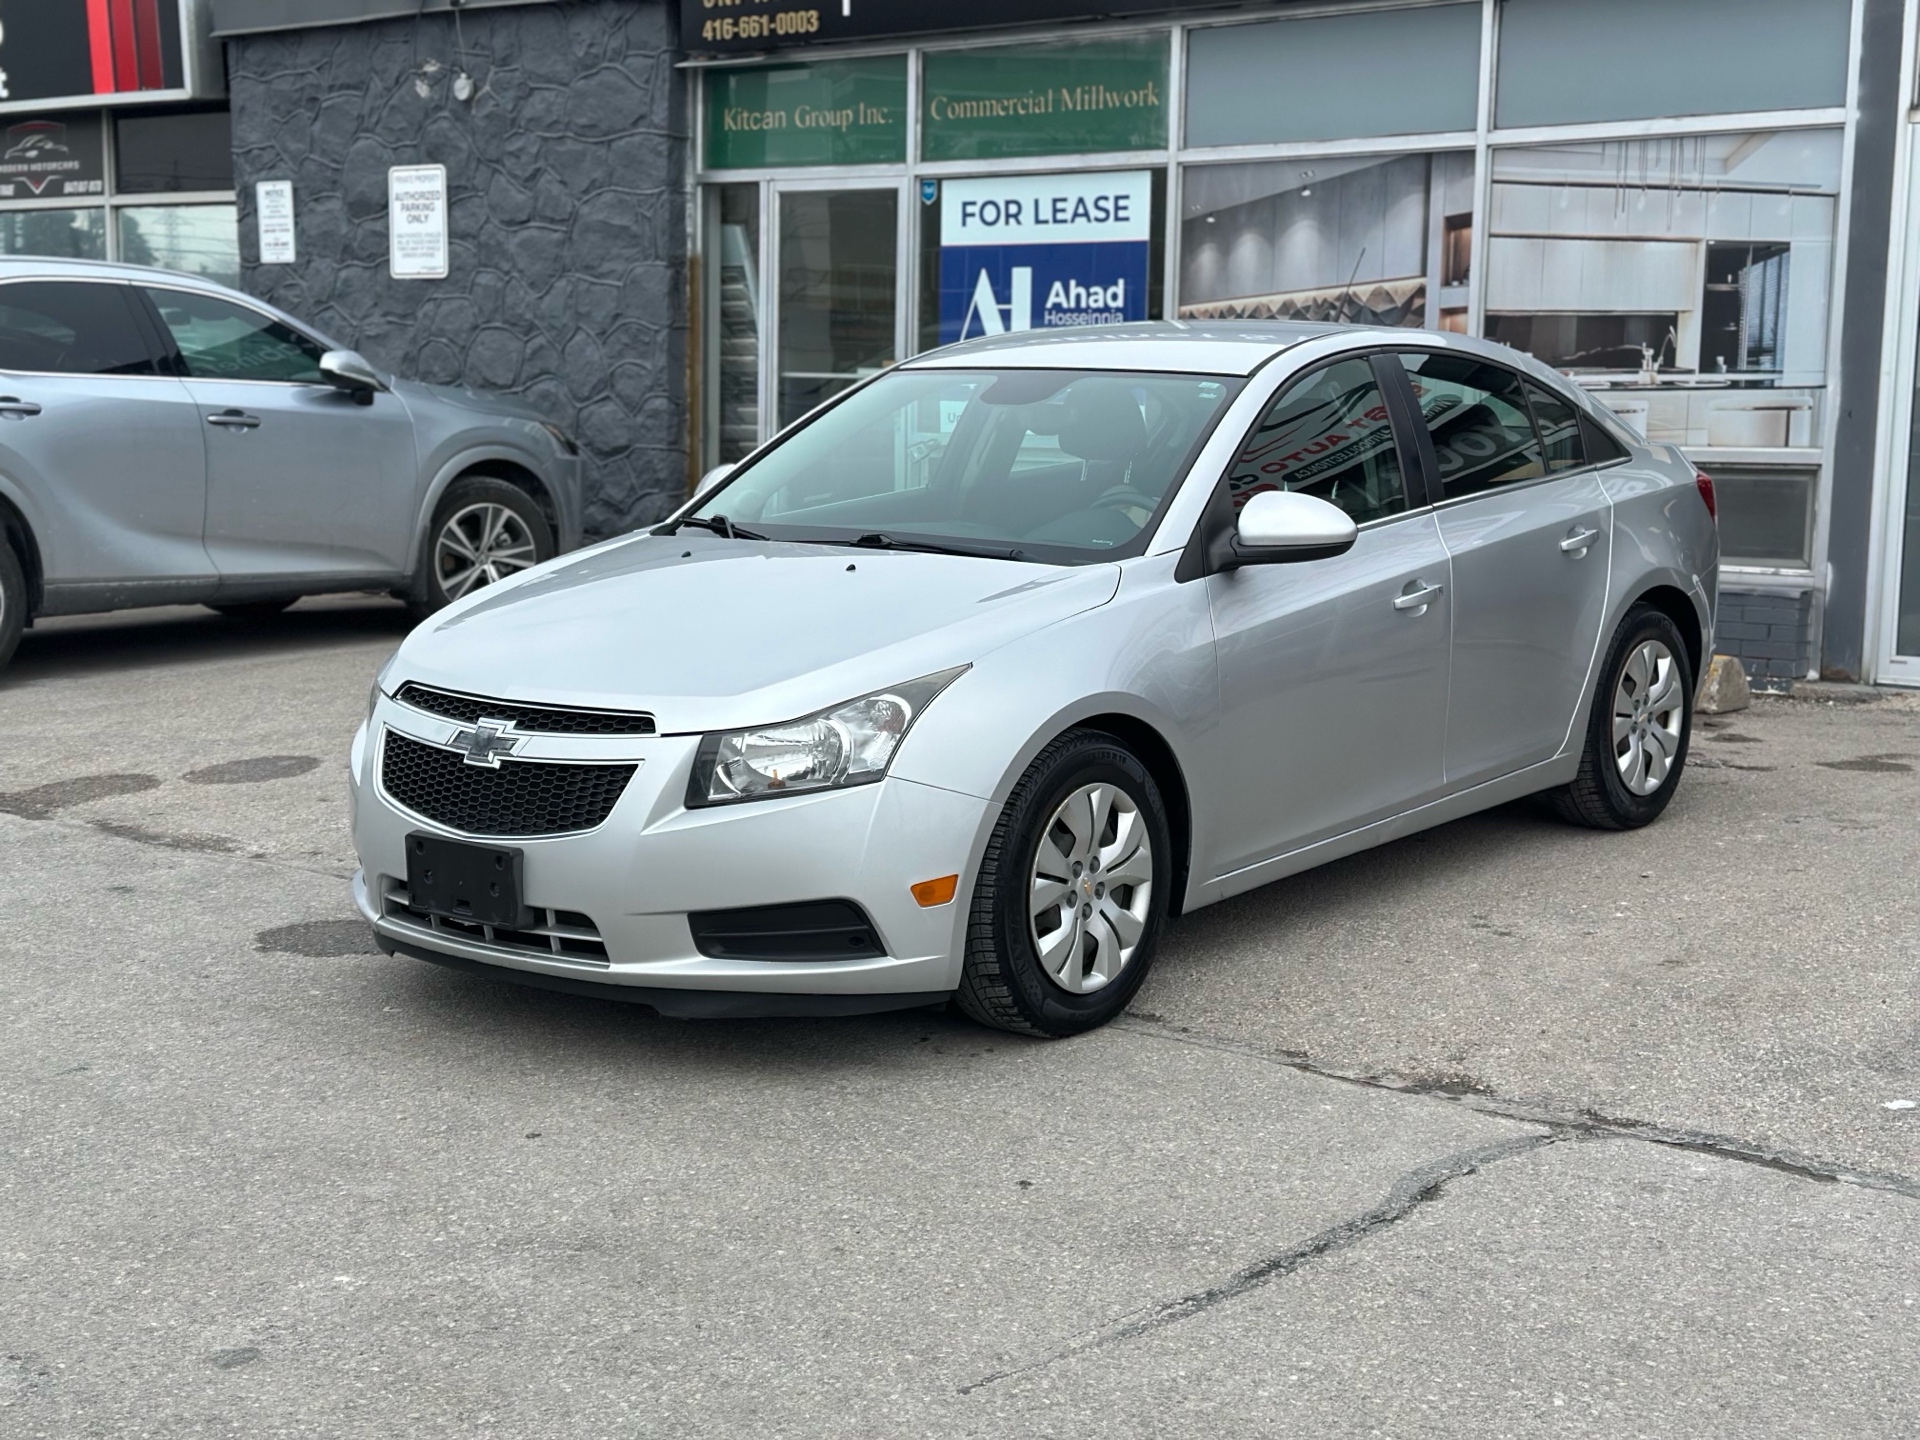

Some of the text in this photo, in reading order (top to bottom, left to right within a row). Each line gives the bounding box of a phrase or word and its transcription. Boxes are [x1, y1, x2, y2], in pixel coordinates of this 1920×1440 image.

[702, 10, 819, 41] 416-661-0003
[930, 81, 1160, 121] Commercial Millwork
[723, 102, 893, 133] Kitcan Group Inc.
[395, 190, 441, 201] AUTHORIZED
[401, 202, 435, 213] PARKING
[961, 194, 1131, 228] FOR LEASE
[406, 213, 429, 224] ONLY
[1045, 278, 1125, 309] Ahad
[1044, 309, 1124, 325] Hosseinnia
